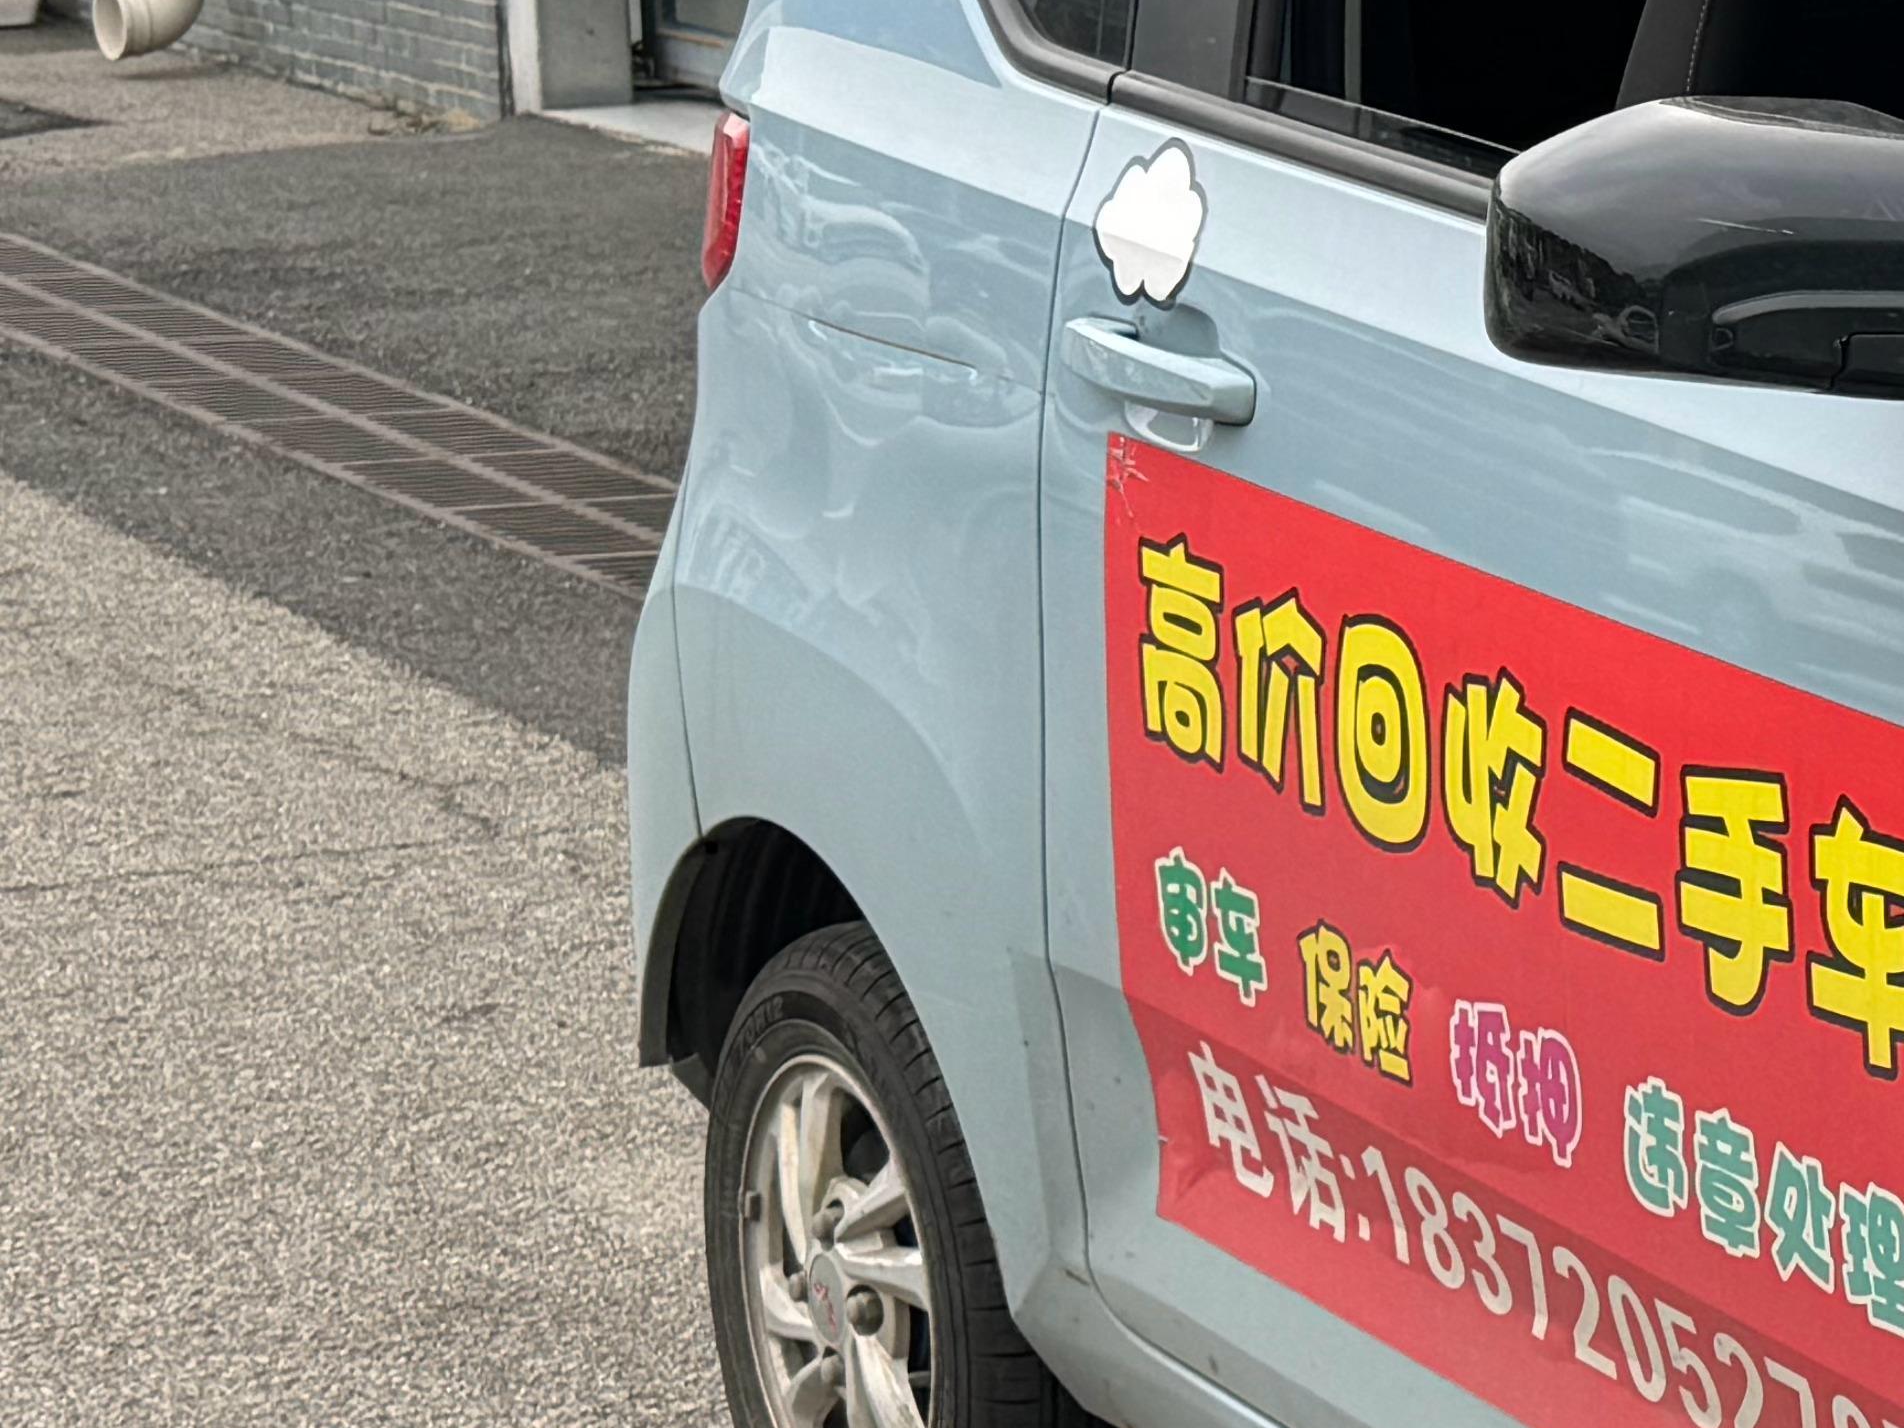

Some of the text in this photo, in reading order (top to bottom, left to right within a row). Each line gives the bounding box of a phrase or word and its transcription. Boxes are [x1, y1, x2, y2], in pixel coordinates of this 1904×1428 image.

[1155, 846, 1268, 1007] 审车
[1297, 918, 1413, 1087] 保险
[1450, 999, 1582, 1168] 抵押
